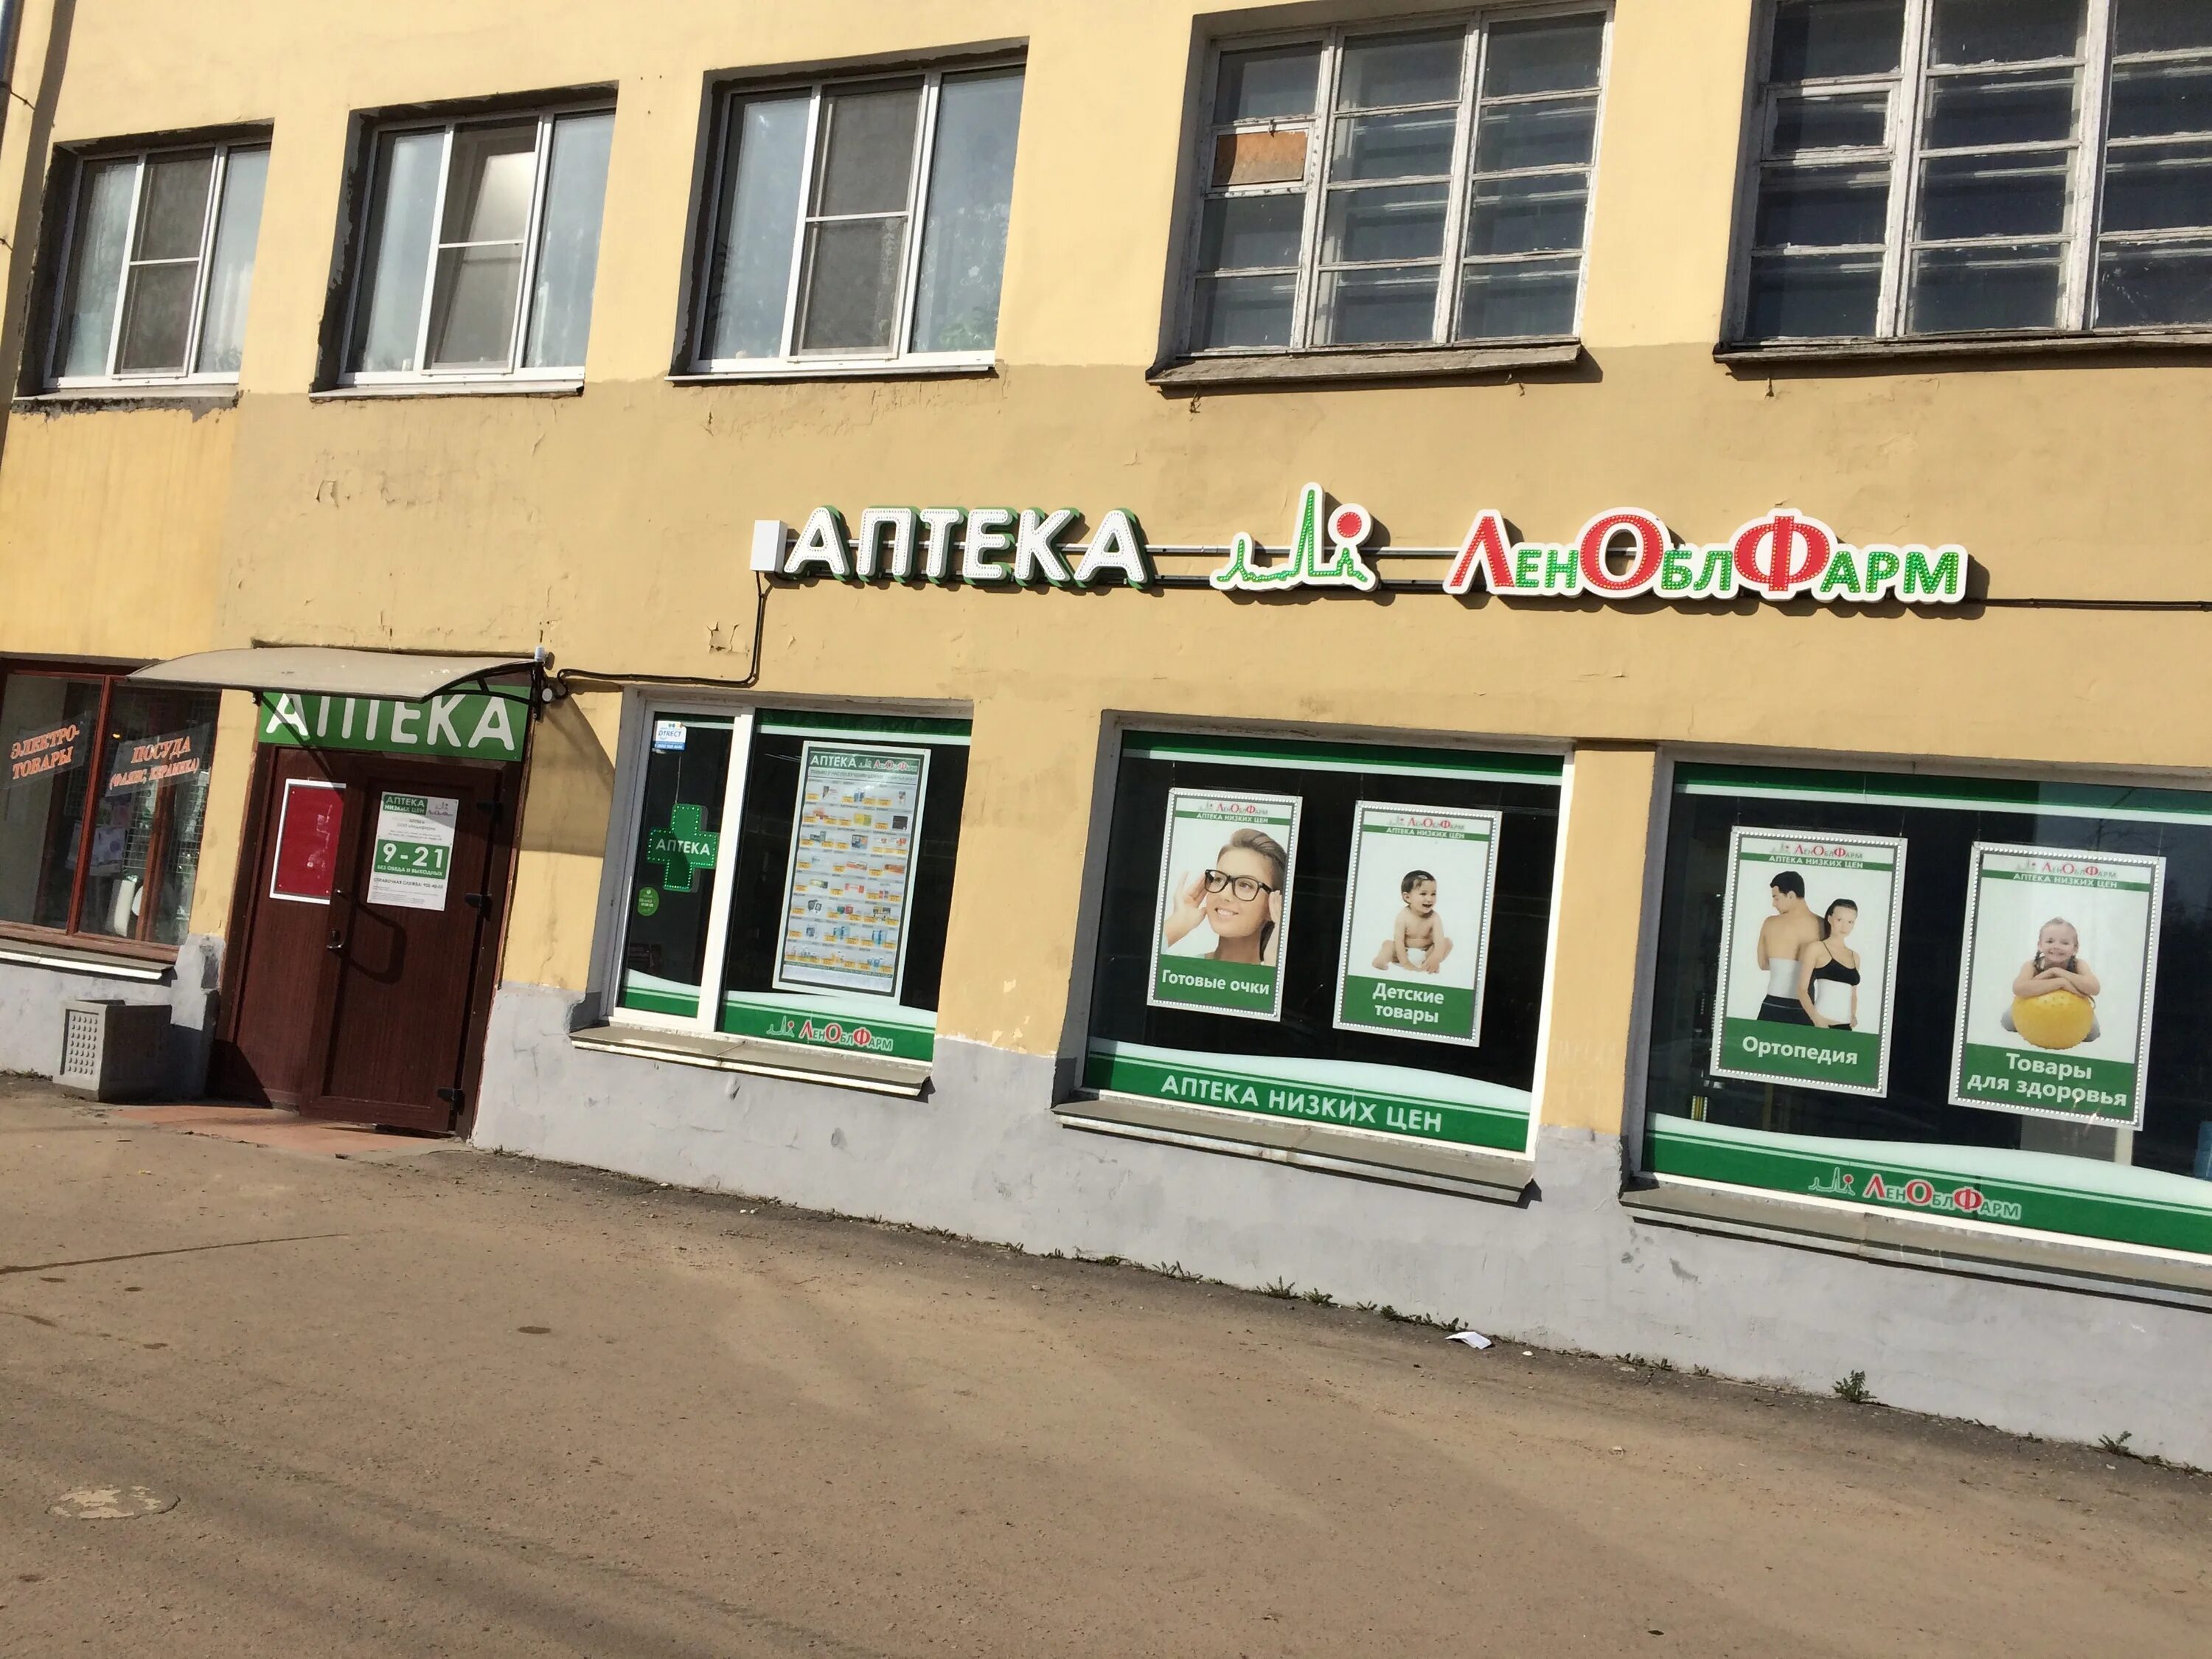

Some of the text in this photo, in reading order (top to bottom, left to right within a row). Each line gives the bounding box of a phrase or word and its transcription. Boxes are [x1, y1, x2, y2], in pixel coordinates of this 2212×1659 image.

[783, 506, 1153, 587] АПТЕКА
[10, 724, 80, 759] ЭЛЕКТРО-
[131, 736, 191, 764] ПОСУДА
[13, 745, 73, 779] ТОВАРЫ
[810, 755, 857, 768] АПТЕКА
[386, 796, 425, 807] АПТЕКА
[1196, 813, 1222, 821] АПТЕКА
[1386, 827, 1415, 835] АПТЕКА
[1416, 830, 1447, 838] НИЗКИХ
[655, 838, 710, 855] АПТЕКА
[1768, 855, 1803, 864] АПТЕКА
[1805, 858, 1842, 867] НИЗКИХ
[2013, 873, 2118, 888] АПТЕКА НИЗКИХ ЦЕН
[1162, 969, 1270, 995] Готовые очки
[1372, 982, 1444, 1004] Детские
[1374, 1004, 1439, 1024] товары
[1742, 1036, 1858, 1065] Ортопедия
[2006, 1052, 2092, 1081] Товары
[1966, 1074, 2127, 1107] для здоровья
[1161, 1075, 1441, 1133] АПТЕКА НИЗКИХ ЦЕН
